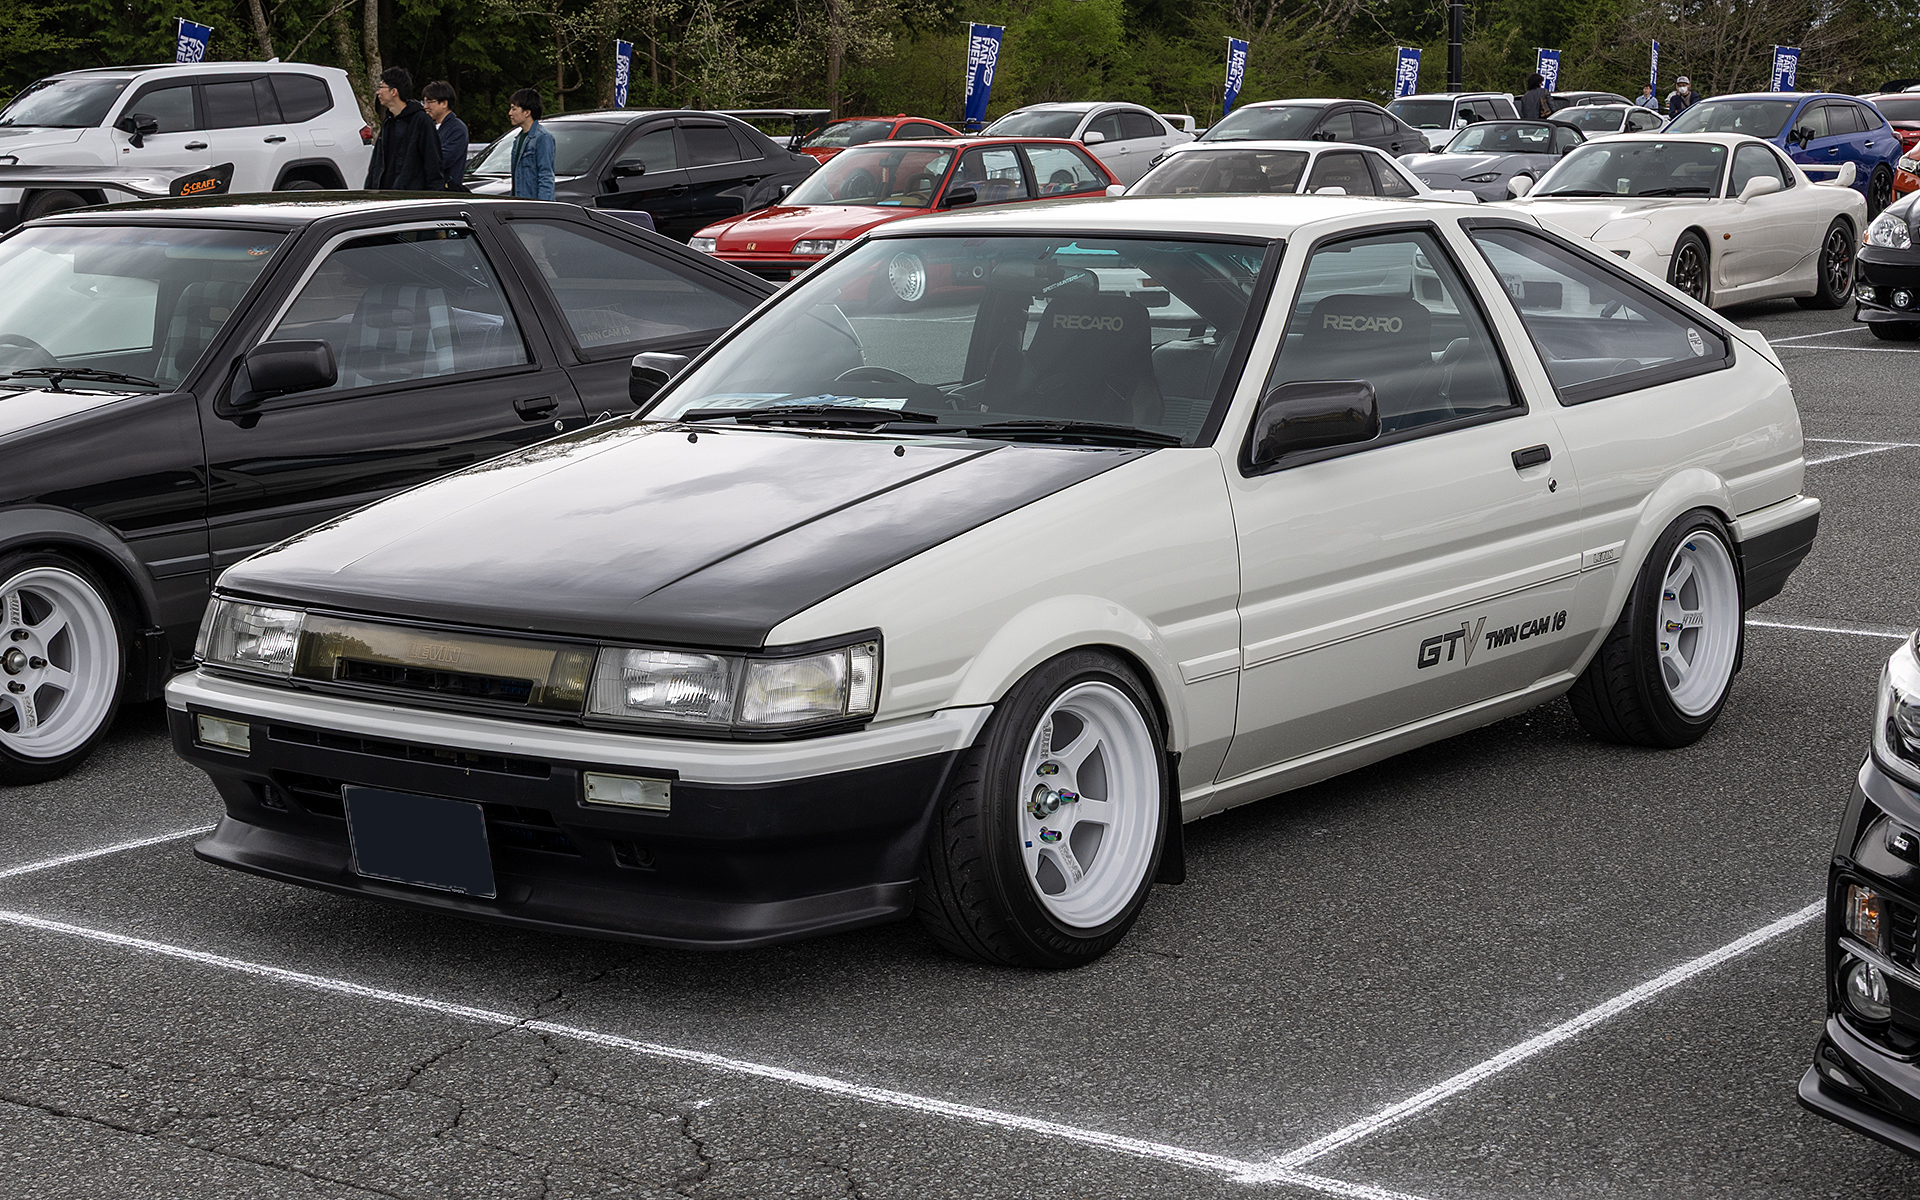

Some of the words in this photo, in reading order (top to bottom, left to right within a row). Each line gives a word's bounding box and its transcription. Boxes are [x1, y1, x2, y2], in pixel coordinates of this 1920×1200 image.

[979, 37, 991, 65] FAN
[967, 35, 982, 96] MEETING
[1404, 58, 1414, 81] FAN
[1546, 59, 1555, 80] FAN
[1772, 53, 1785, 92] MEETING
[1782, 54, 1791, 73] FAN
[1394, 57, 1408, 98] MEETIN
[180, 178, 216, 196] S-CRAFT
[1053, 314, 1124, 332] RECARO
[1323, 313, 1403, 333] RECARO
[580, 331, 602, 342] TWIN
[601, 327, 621, 339] CAM
[1485, 624, 1520, 650] TWIN
[1519, 615, 1551, 640] CAM
[1551, 609, 1567, 632] 16
[406, 641, 462, 663] LEVIN
